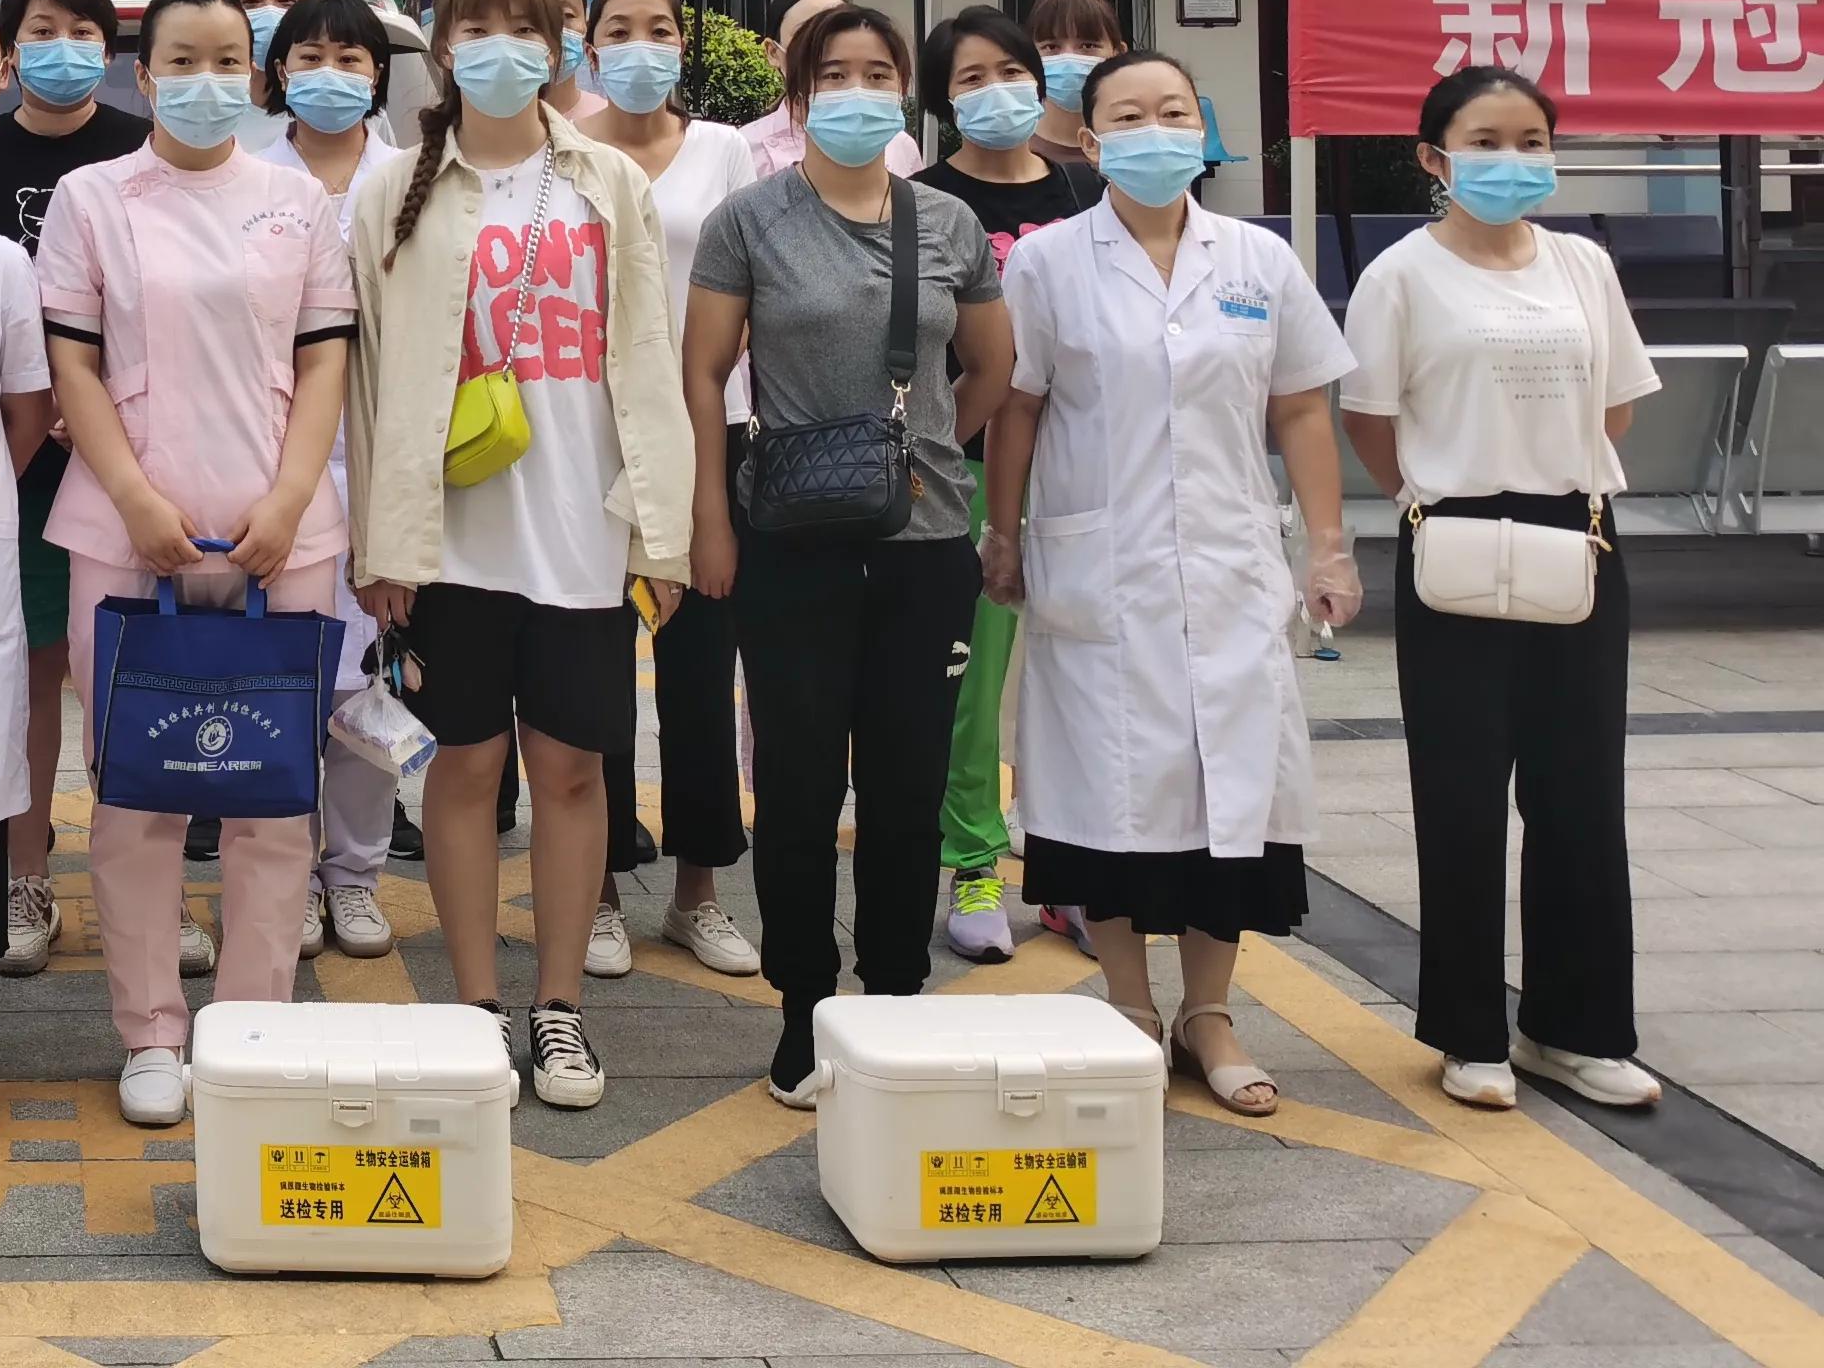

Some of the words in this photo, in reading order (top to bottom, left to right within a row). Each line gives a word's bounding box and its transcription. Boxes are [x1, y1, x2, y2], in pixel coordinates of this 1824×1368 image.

[354, 1150, 431, 1169] 生物安全运输箱
[1014, 1152, 1088, 1170] 生物安全运输箱
[280, 1198, 344, 1220] 送检专用
[939, 1203, 1002, 1223] 送检专用
